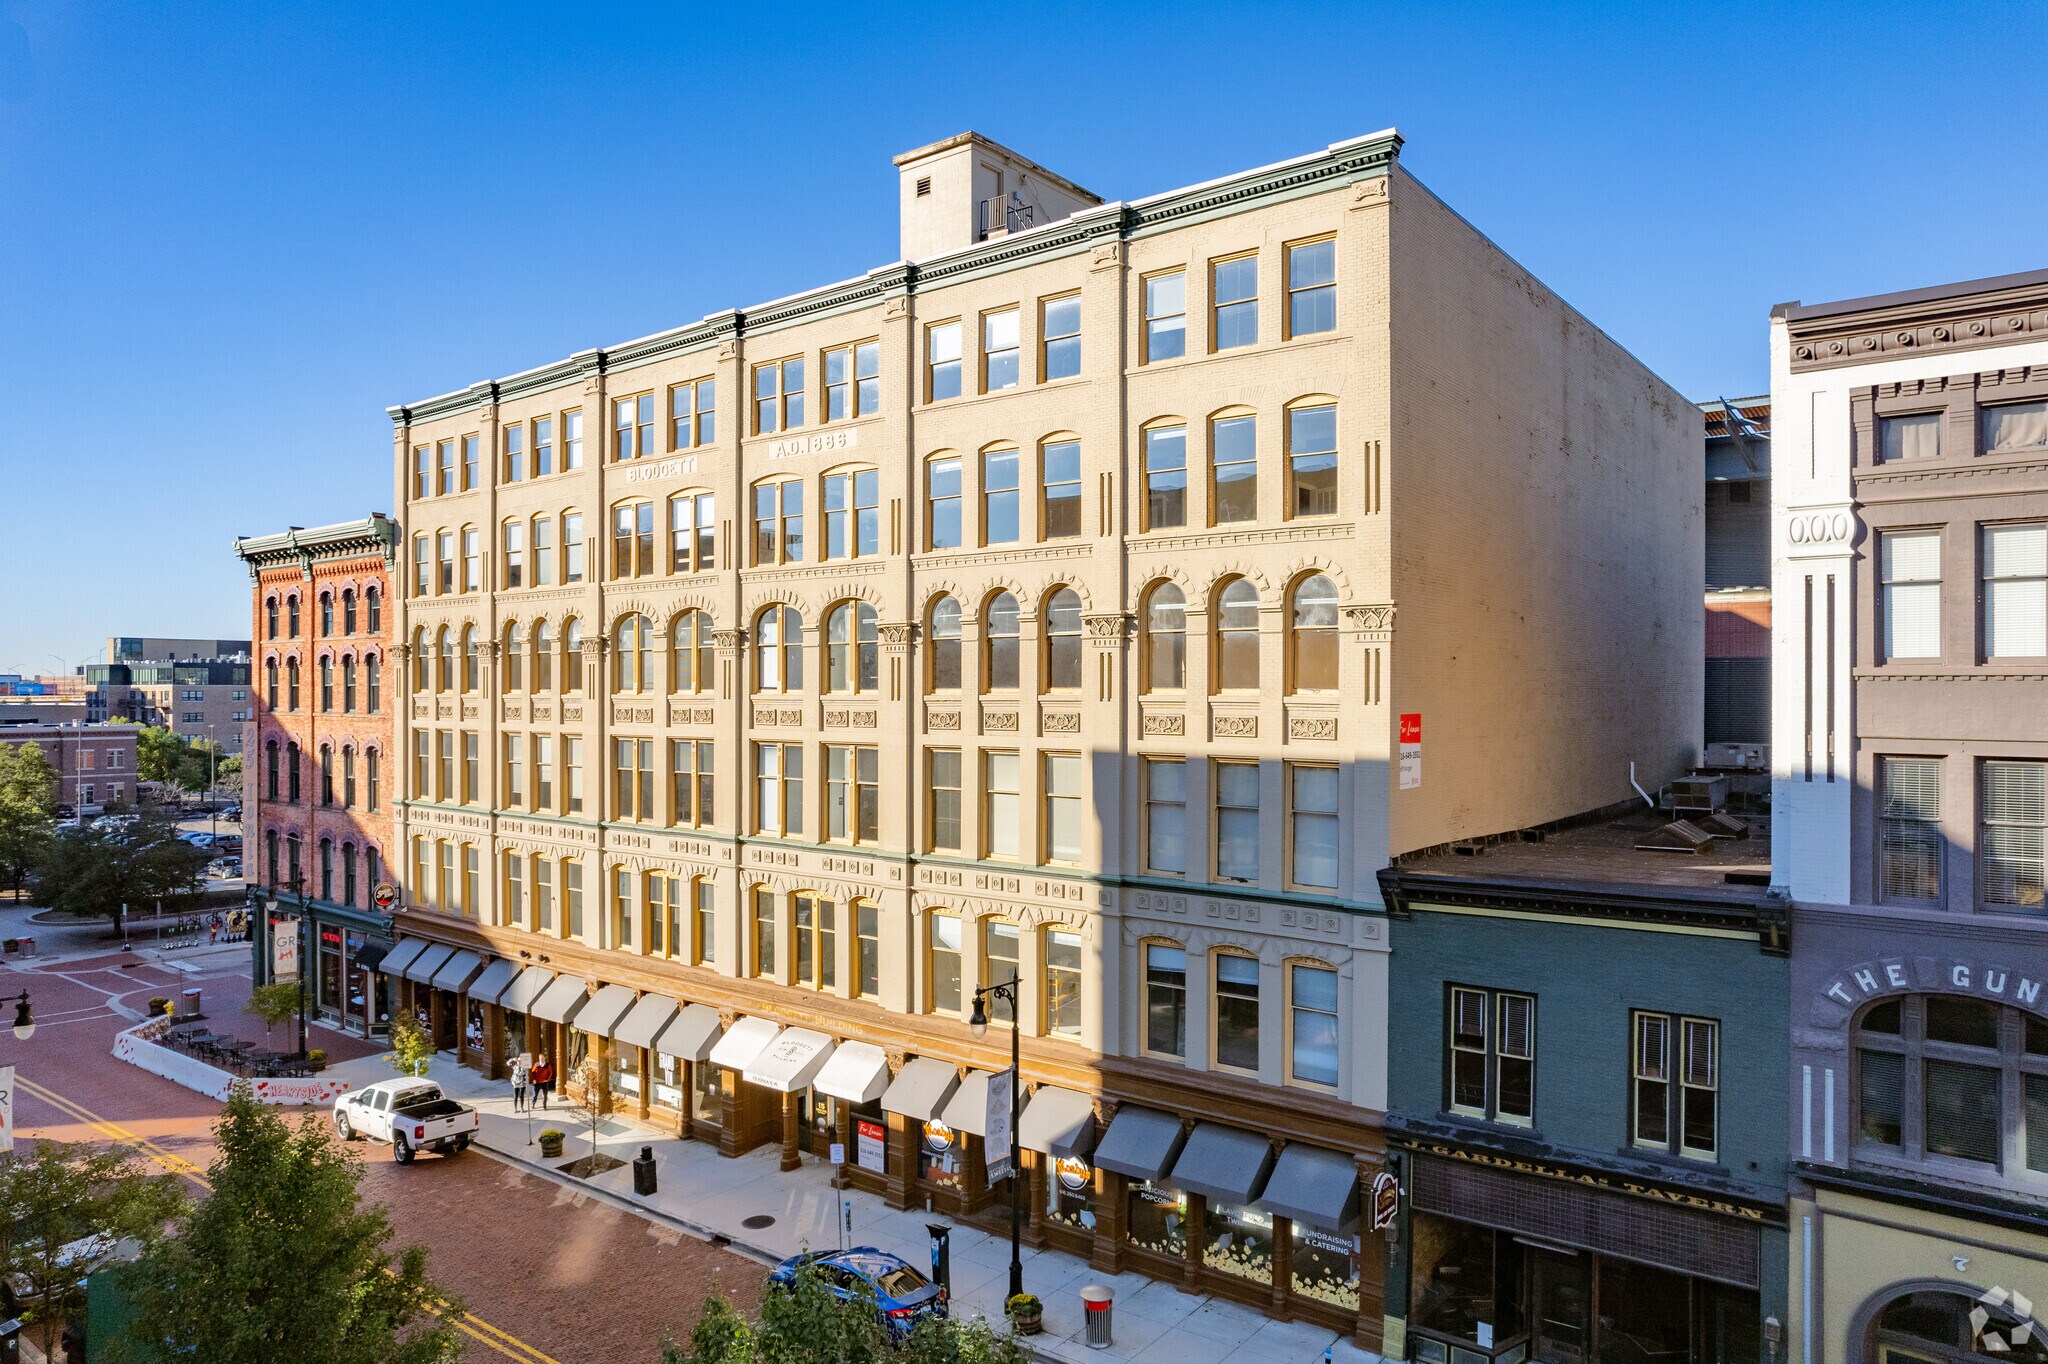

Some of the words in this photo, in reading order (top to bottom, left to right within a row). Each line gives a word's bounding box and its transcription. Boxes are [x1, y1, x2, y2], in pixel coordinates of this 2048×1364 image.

[628, 458, 695, 482] BLODGETT
[276, 935, 296, 948] GR
[1828, 965, 1907, 1003] THE
[1952, 965, 2041, 1003] GUN
[814, 1014, 864, 1035] BUILDING
[269, 1082, 323, 1099] HEARTSIDE
[1140, 1184, 1174, 1199] DELICIOUS
[1141, 1193, 1172, 1205] POPCORN
[1623, 1182, 1764, 1219] TAVERN
[1304, 1228, 1353, 1248] FUNDRAISING
[1312, 1241, 1350, 1256] CATERING
[9, 1339, 16, 1349] P
